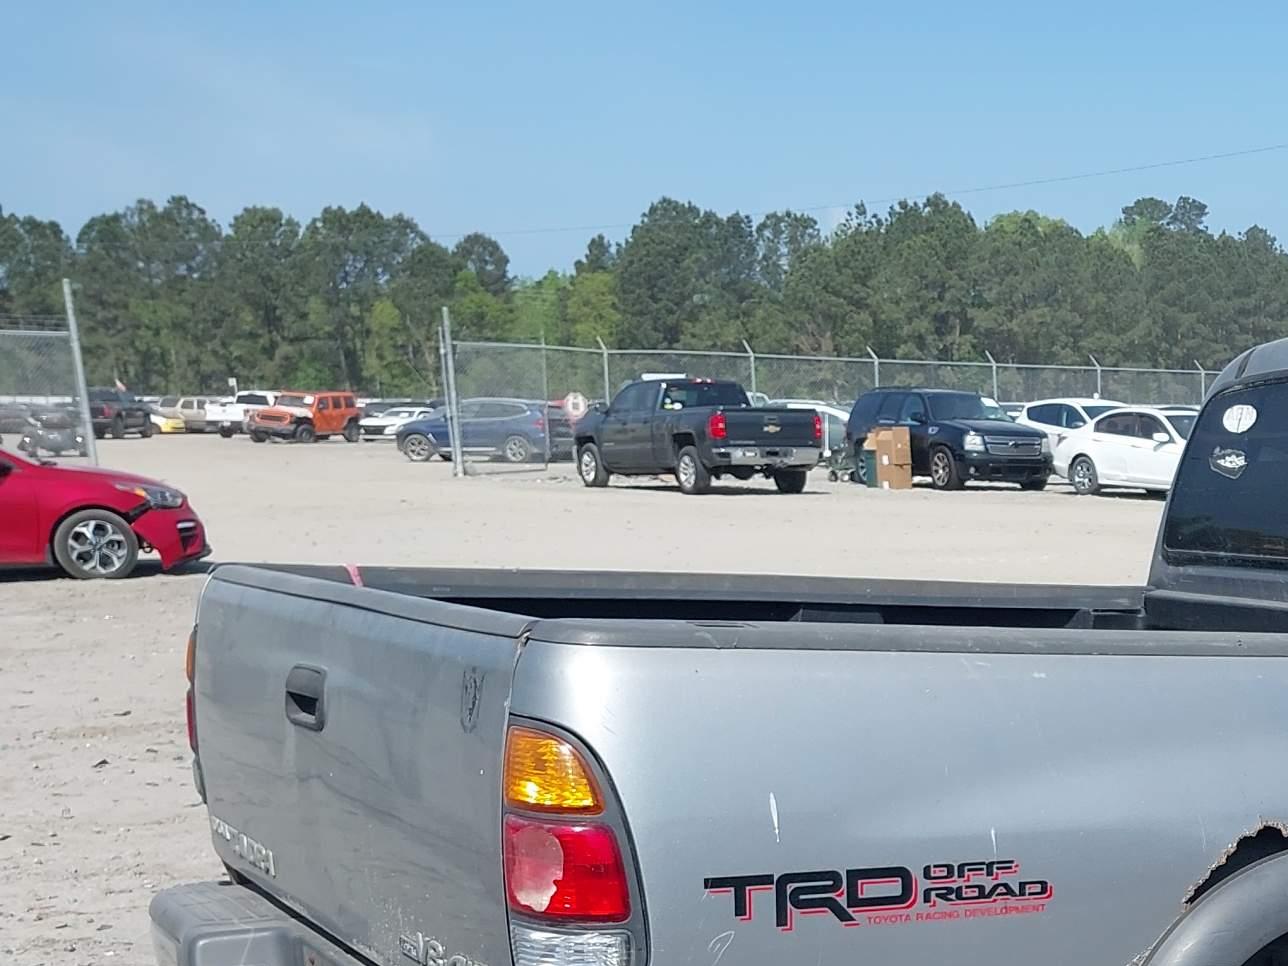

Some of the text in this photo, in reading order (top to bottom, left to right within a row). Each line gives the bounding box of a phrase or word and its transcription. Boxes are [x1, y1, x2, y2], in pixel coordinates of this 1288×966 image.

[922, 860, 1019, 884] OFF
[703, 865, 918, 931] TRD
[922, 880, 1053, 907] ROAD
[866, 903, 1047, 926] TOYOTA RACING DEVELOPMENT
